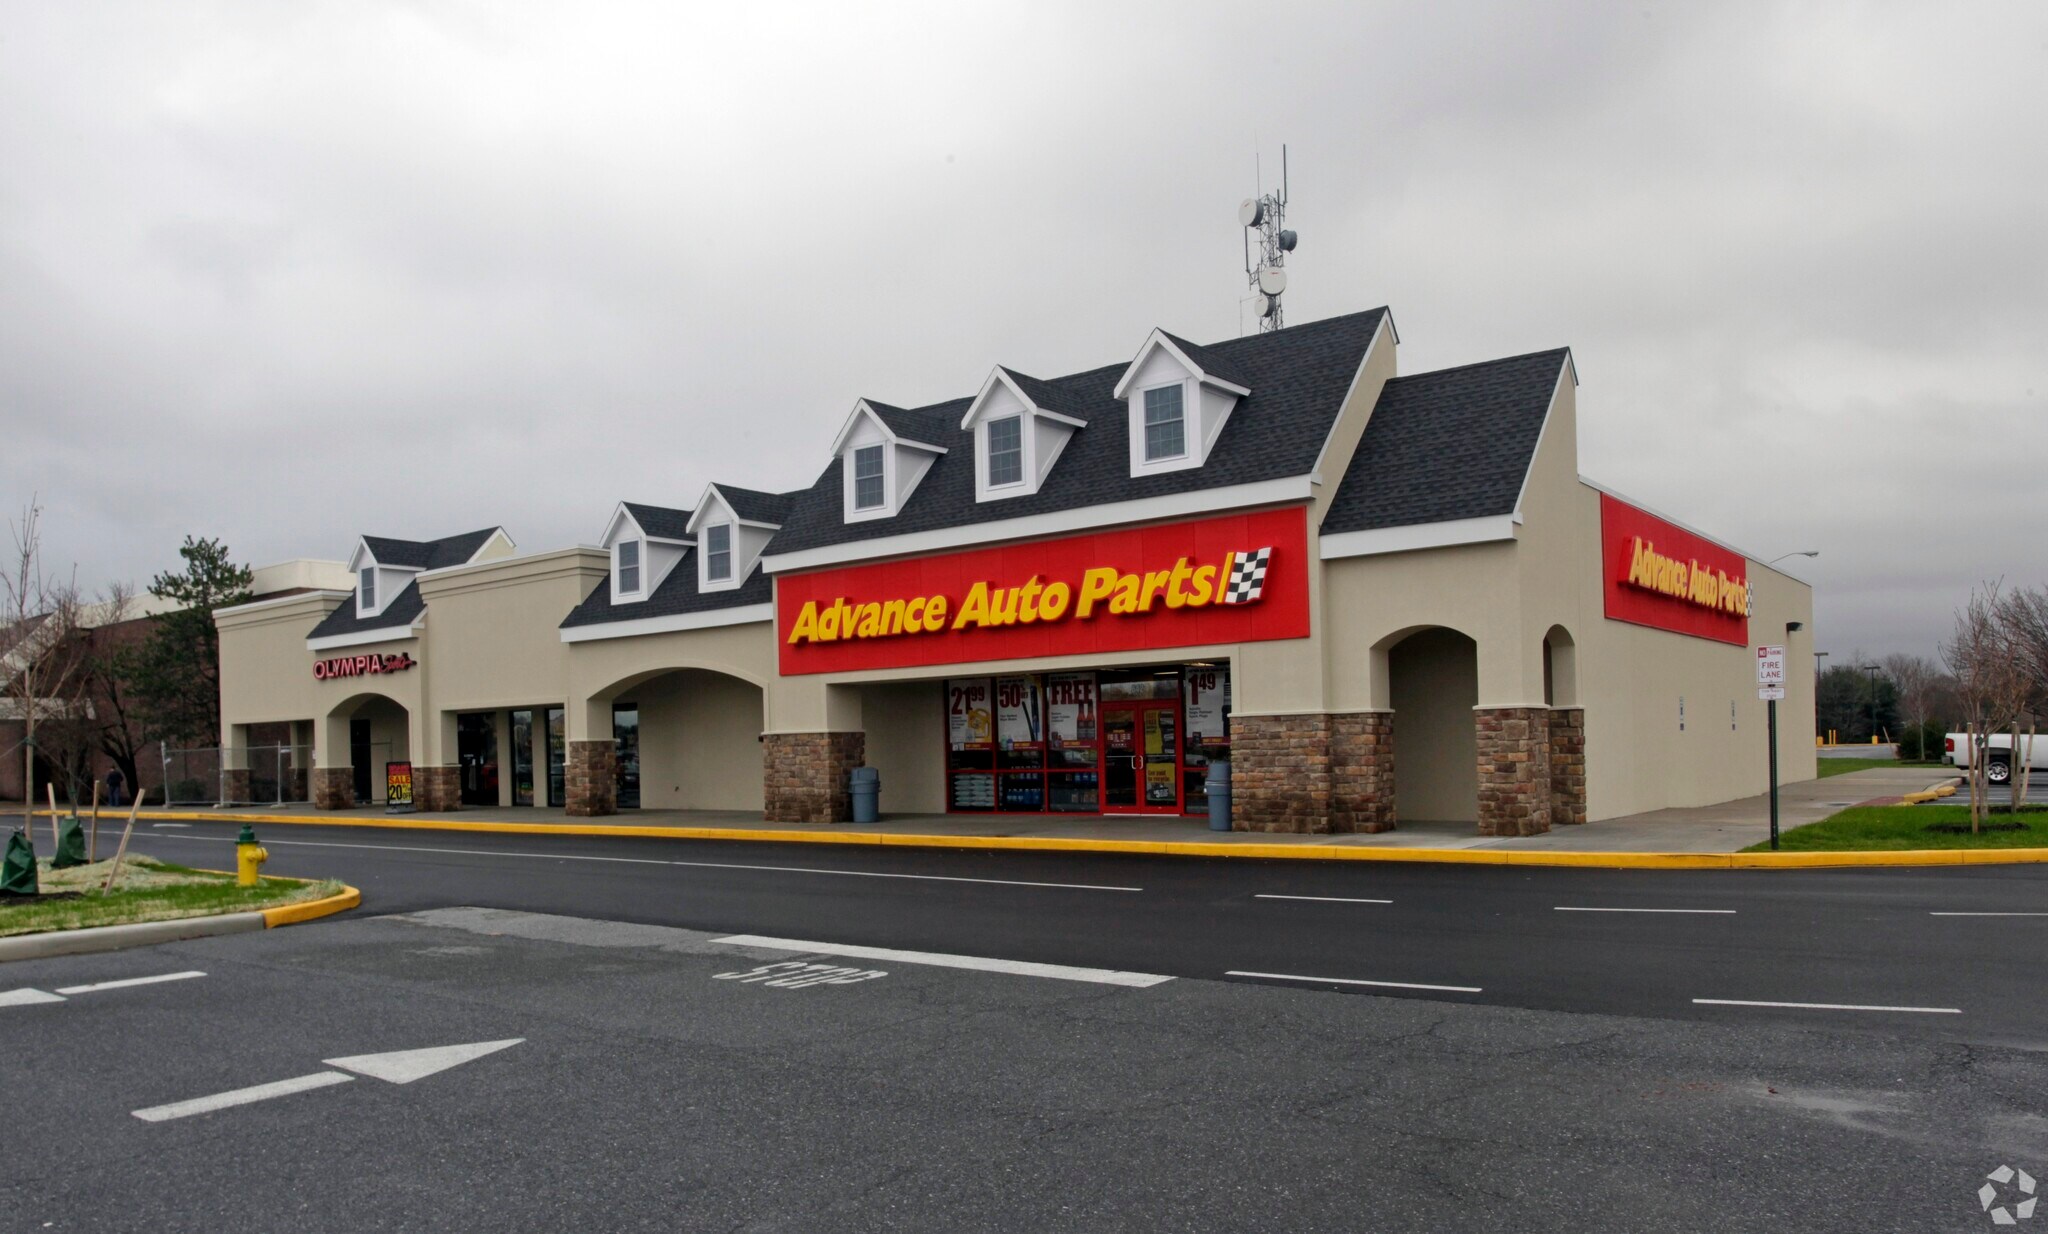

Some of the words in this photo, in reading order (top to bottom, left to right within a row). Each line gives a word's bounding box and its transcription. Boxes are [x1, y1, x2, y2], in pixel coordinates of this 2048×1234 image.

[1628, 536, 1688, 598] Advance
[1687, 558, 1718, 608] Auto
[1718, 570, 1746, 616] Parts
[787, 594, 947, 645] Advance
[952, 575, 1071, 630] Auto
[1075, 557, 1217, 619] Parts
[313, 654, 382, 680] OLYMPIA
[1760, 670, 1781, 679] LANE
[1761, 661, 1780, 669] FIRE
[1050, 680, 1093, 705] FREE
[389, 776, 411, 784] SALE
[712, 961, 889, 989] STOP
